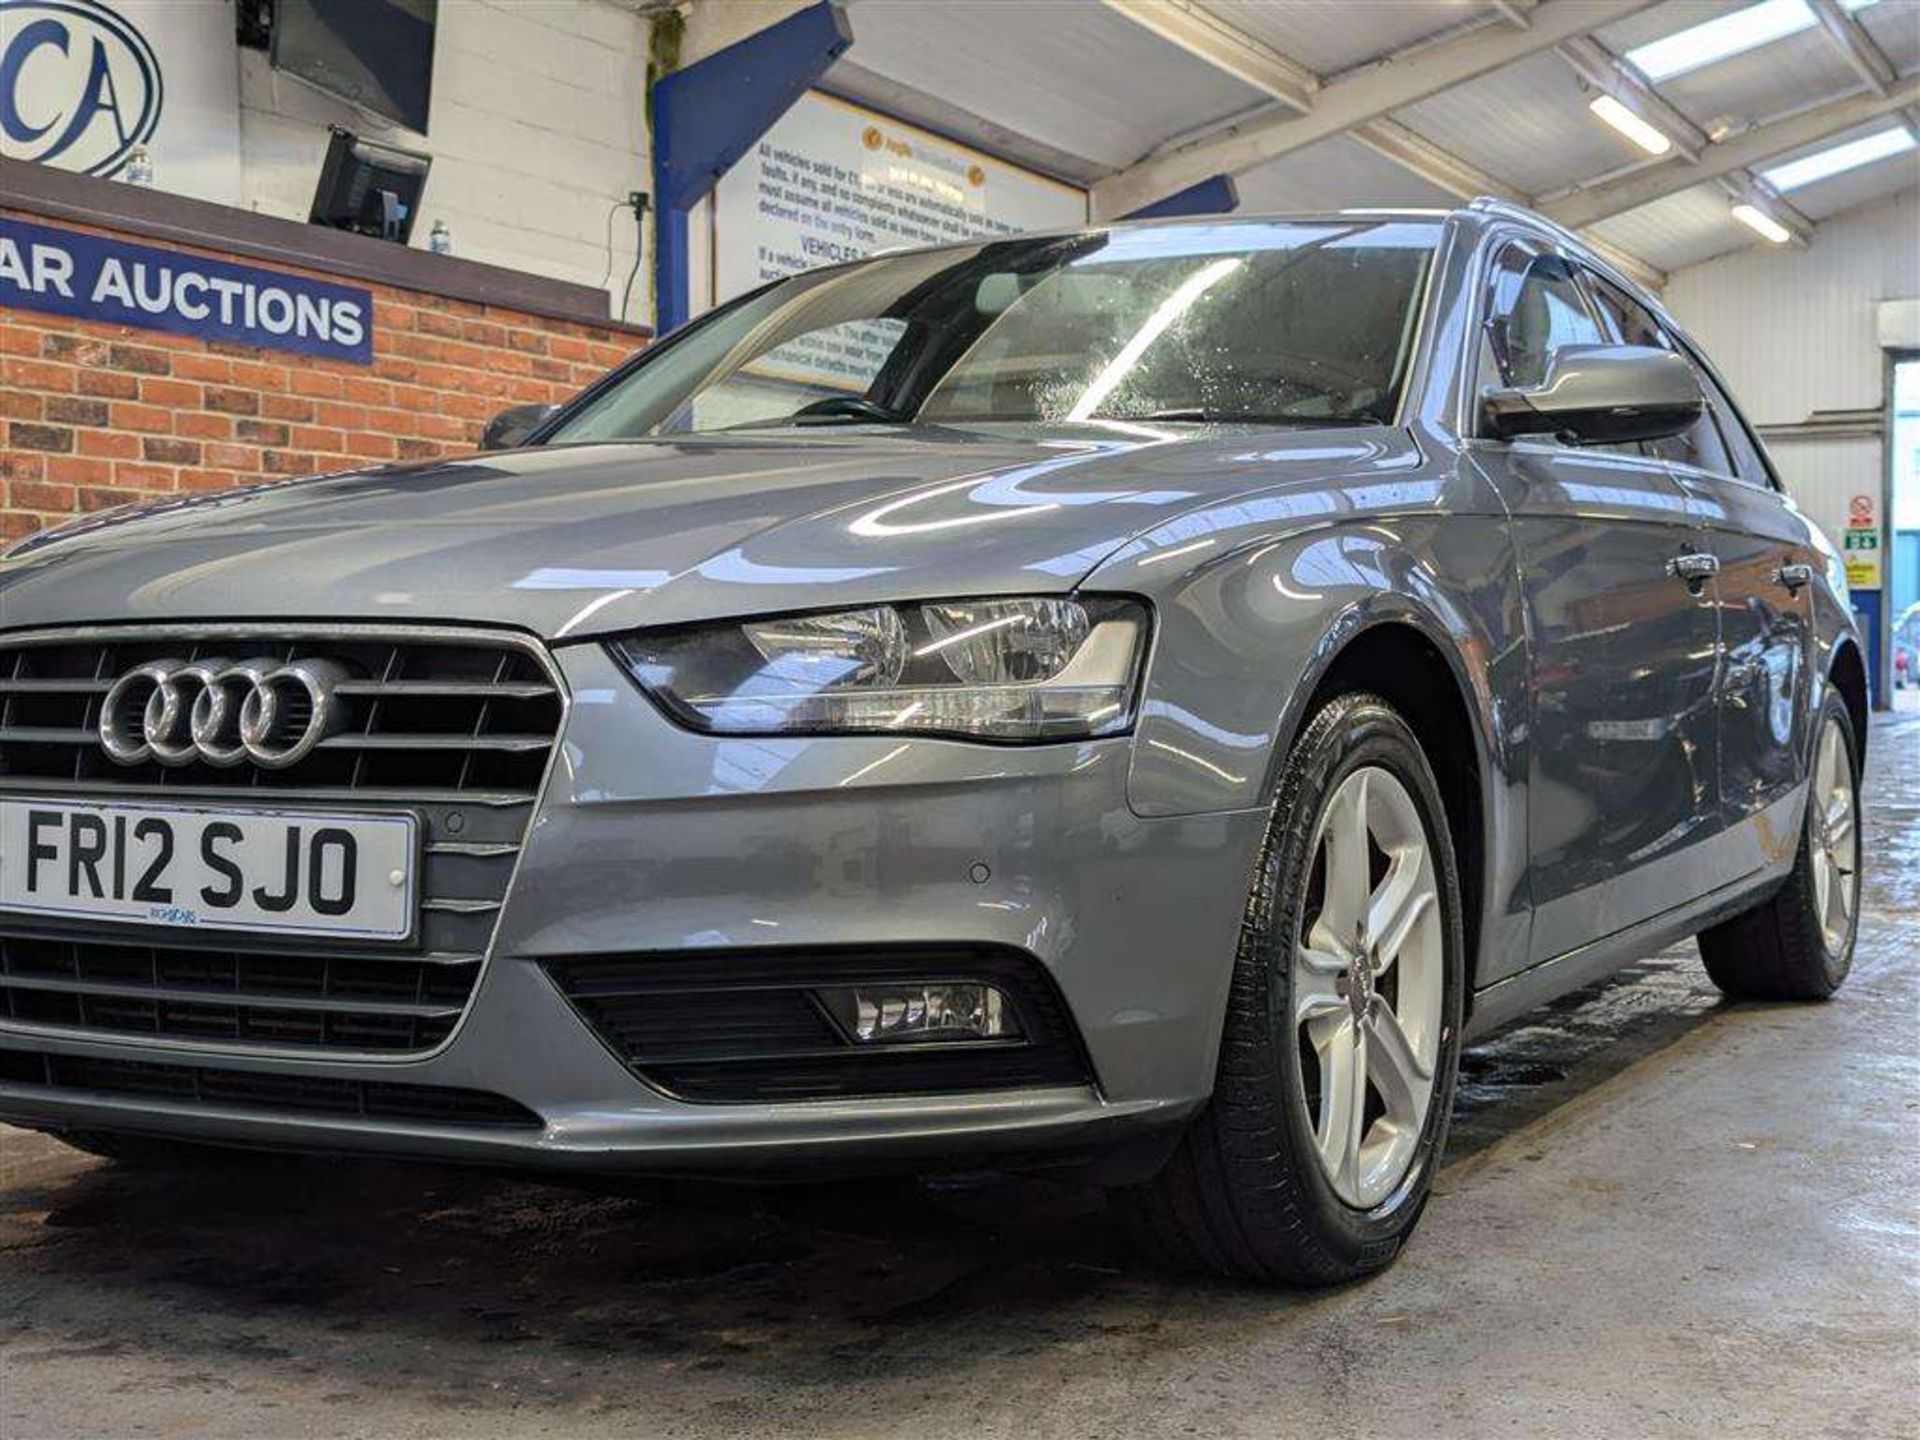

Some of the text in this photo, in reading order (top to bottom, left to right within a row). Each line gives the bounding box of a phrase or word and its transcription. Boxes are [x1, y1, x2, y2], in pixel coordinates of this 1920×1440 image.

[773, 150, 811, 171] vehicles
[812, 162, 832, 177] sold
[91, 258, 364, 346] AUCTIONS
[26, 809, 358, 916] FR12 SJO
